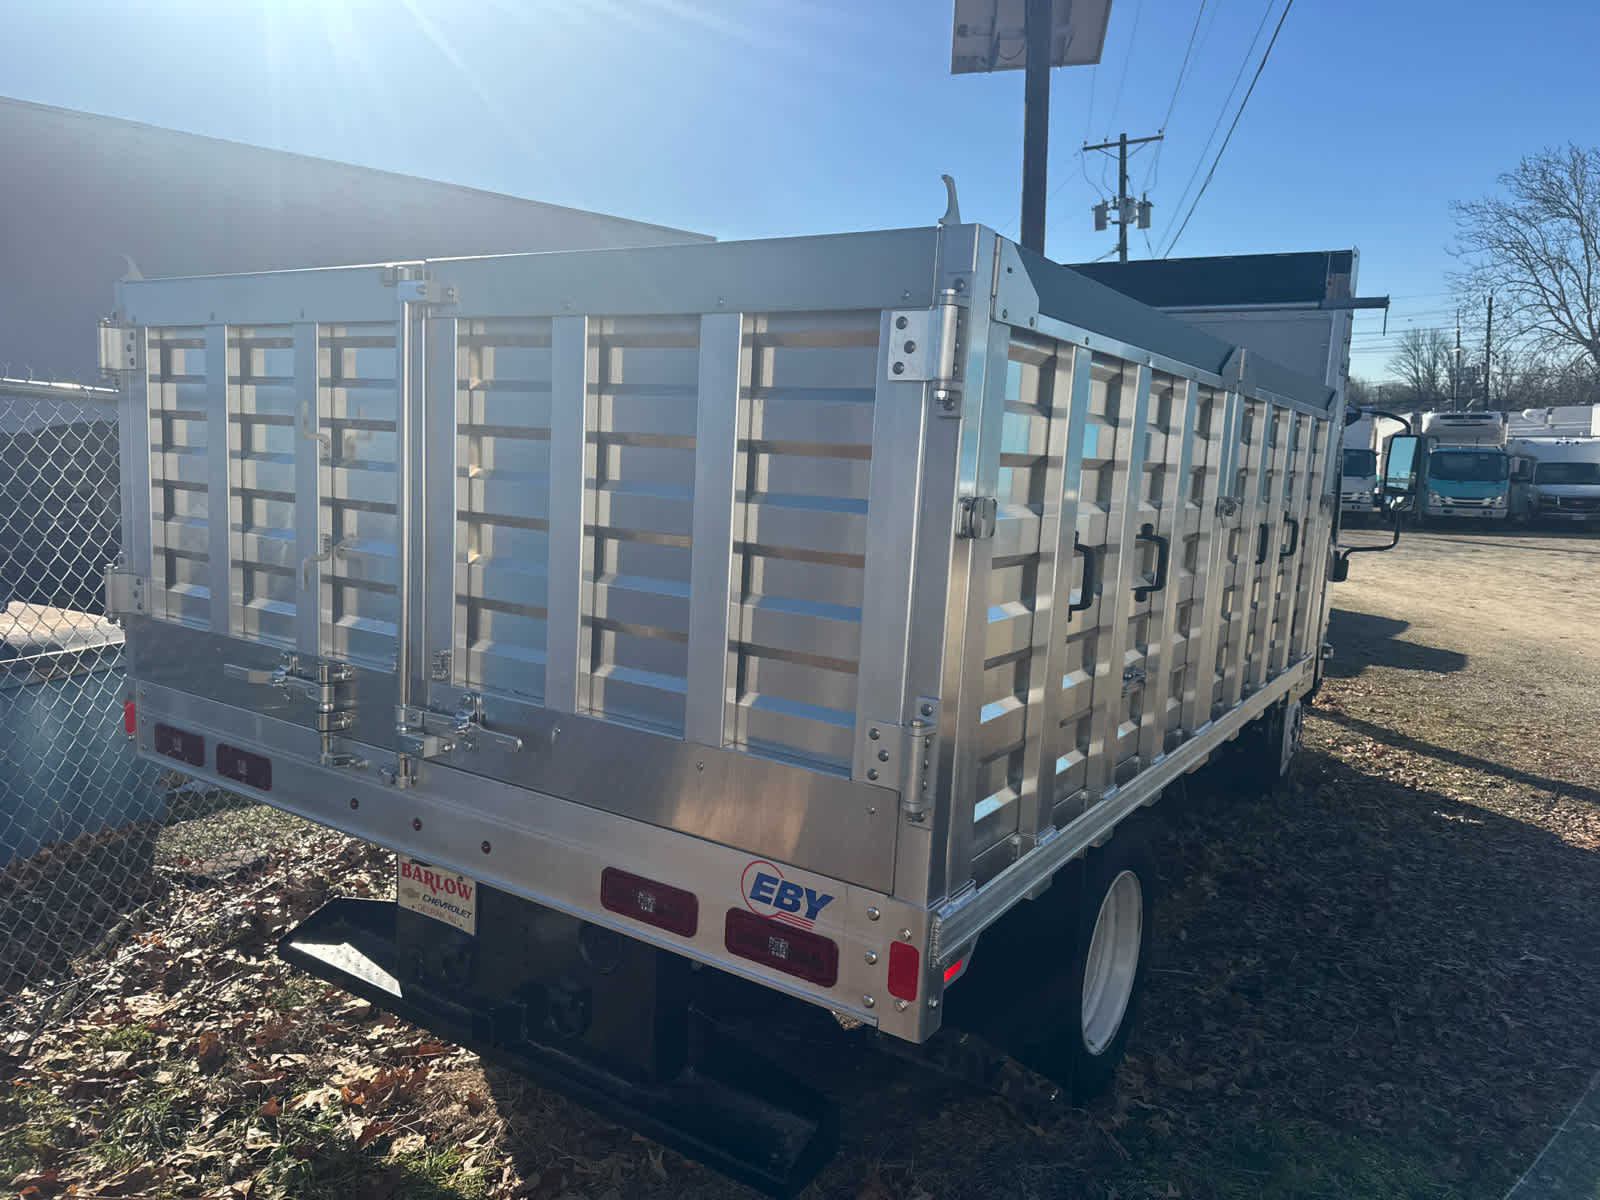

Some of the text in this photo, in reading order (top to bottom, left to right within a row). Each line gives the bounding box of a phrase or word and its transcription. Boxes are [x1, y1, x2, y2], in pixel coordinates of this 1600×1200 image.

[400, 862, 473, 900] BARLOW
[749, 871, 834, 921] EBY
[422, 894, 473, 919] CHEVROLET
